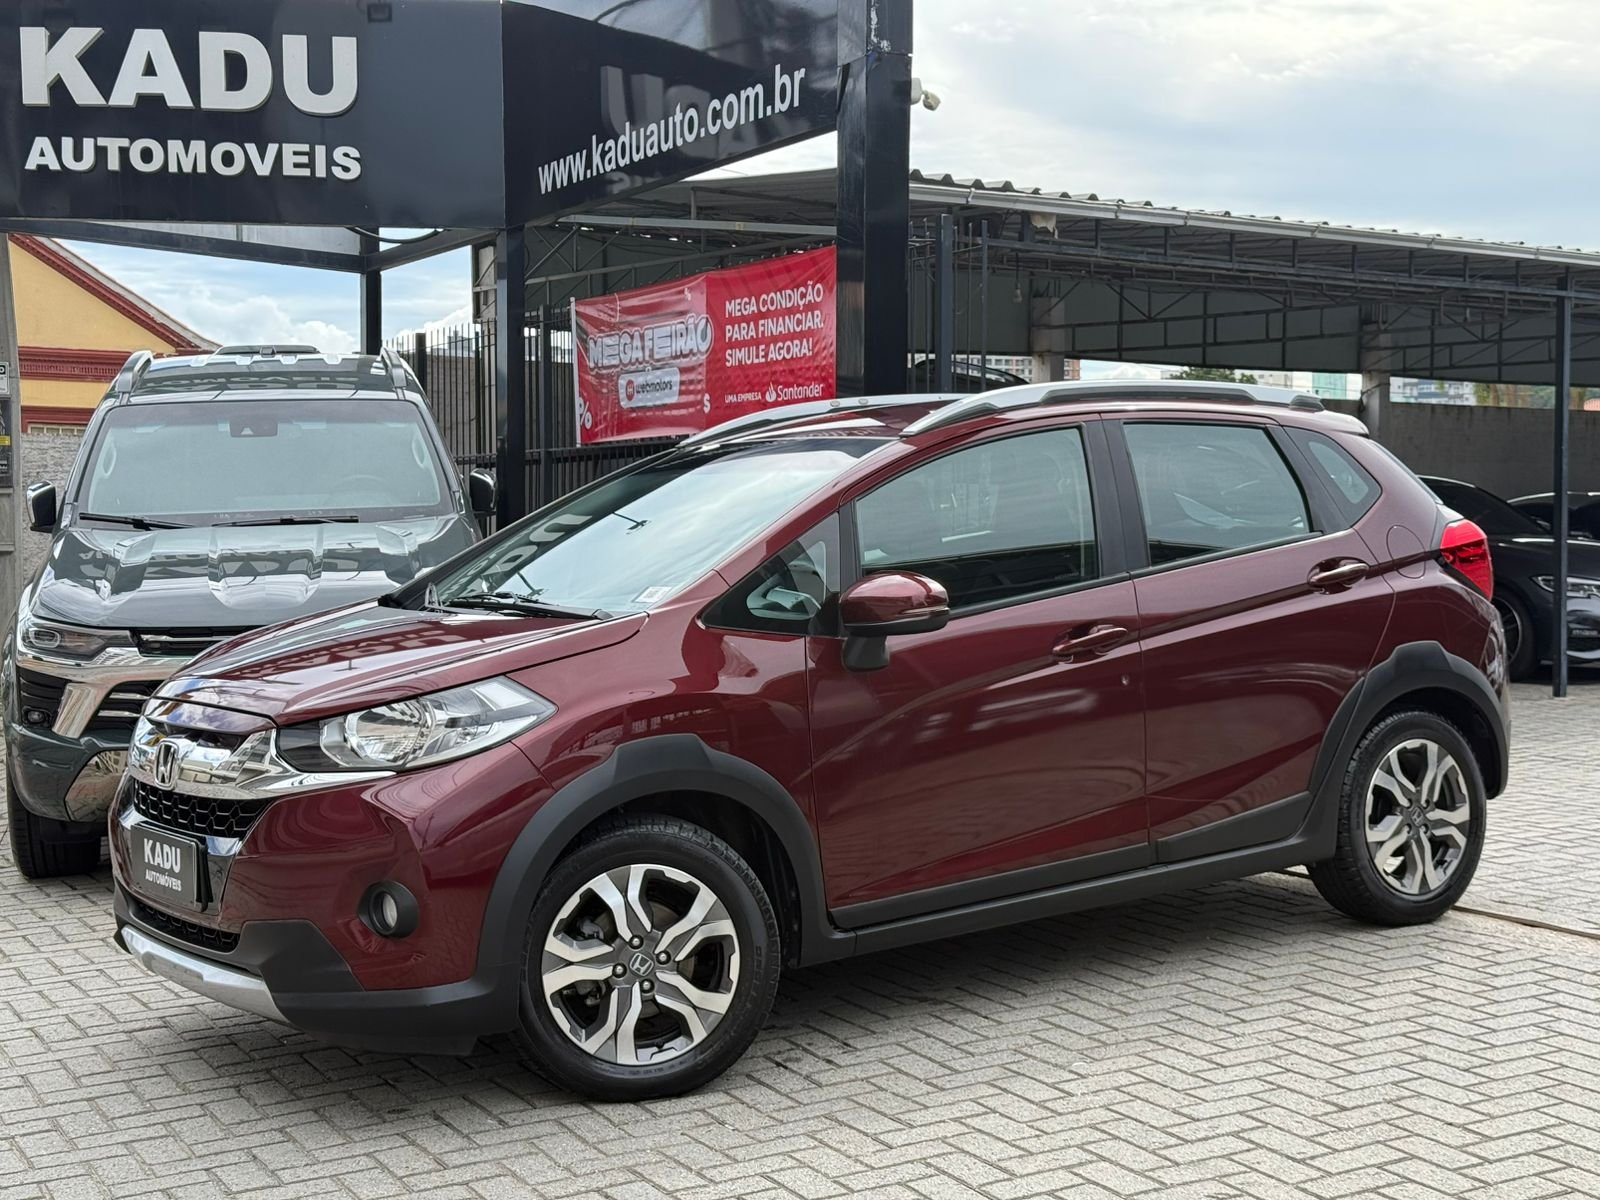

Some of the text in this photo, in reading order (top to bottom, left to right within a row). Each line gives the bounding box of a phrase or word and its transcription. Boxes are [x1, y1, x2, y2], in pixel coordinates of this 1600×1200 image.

[19, 26, 358, 117] KADU
[538, 63, 806, 195] www.kaduauto.com.br
[24, 136, 362, 181] AUTOMOVEIS
[725, 280, 824, 318] MEGA CONDIÇÃO
[725, 321, 756, 342] PARA
[725, 337, 812, 367] SIMULE AGORA!
[636, 379, 672, 393] webmotors
[724, 381, 824, 403] UMA EMPRESA Santander
[143, 838, 181, 873] KADU
